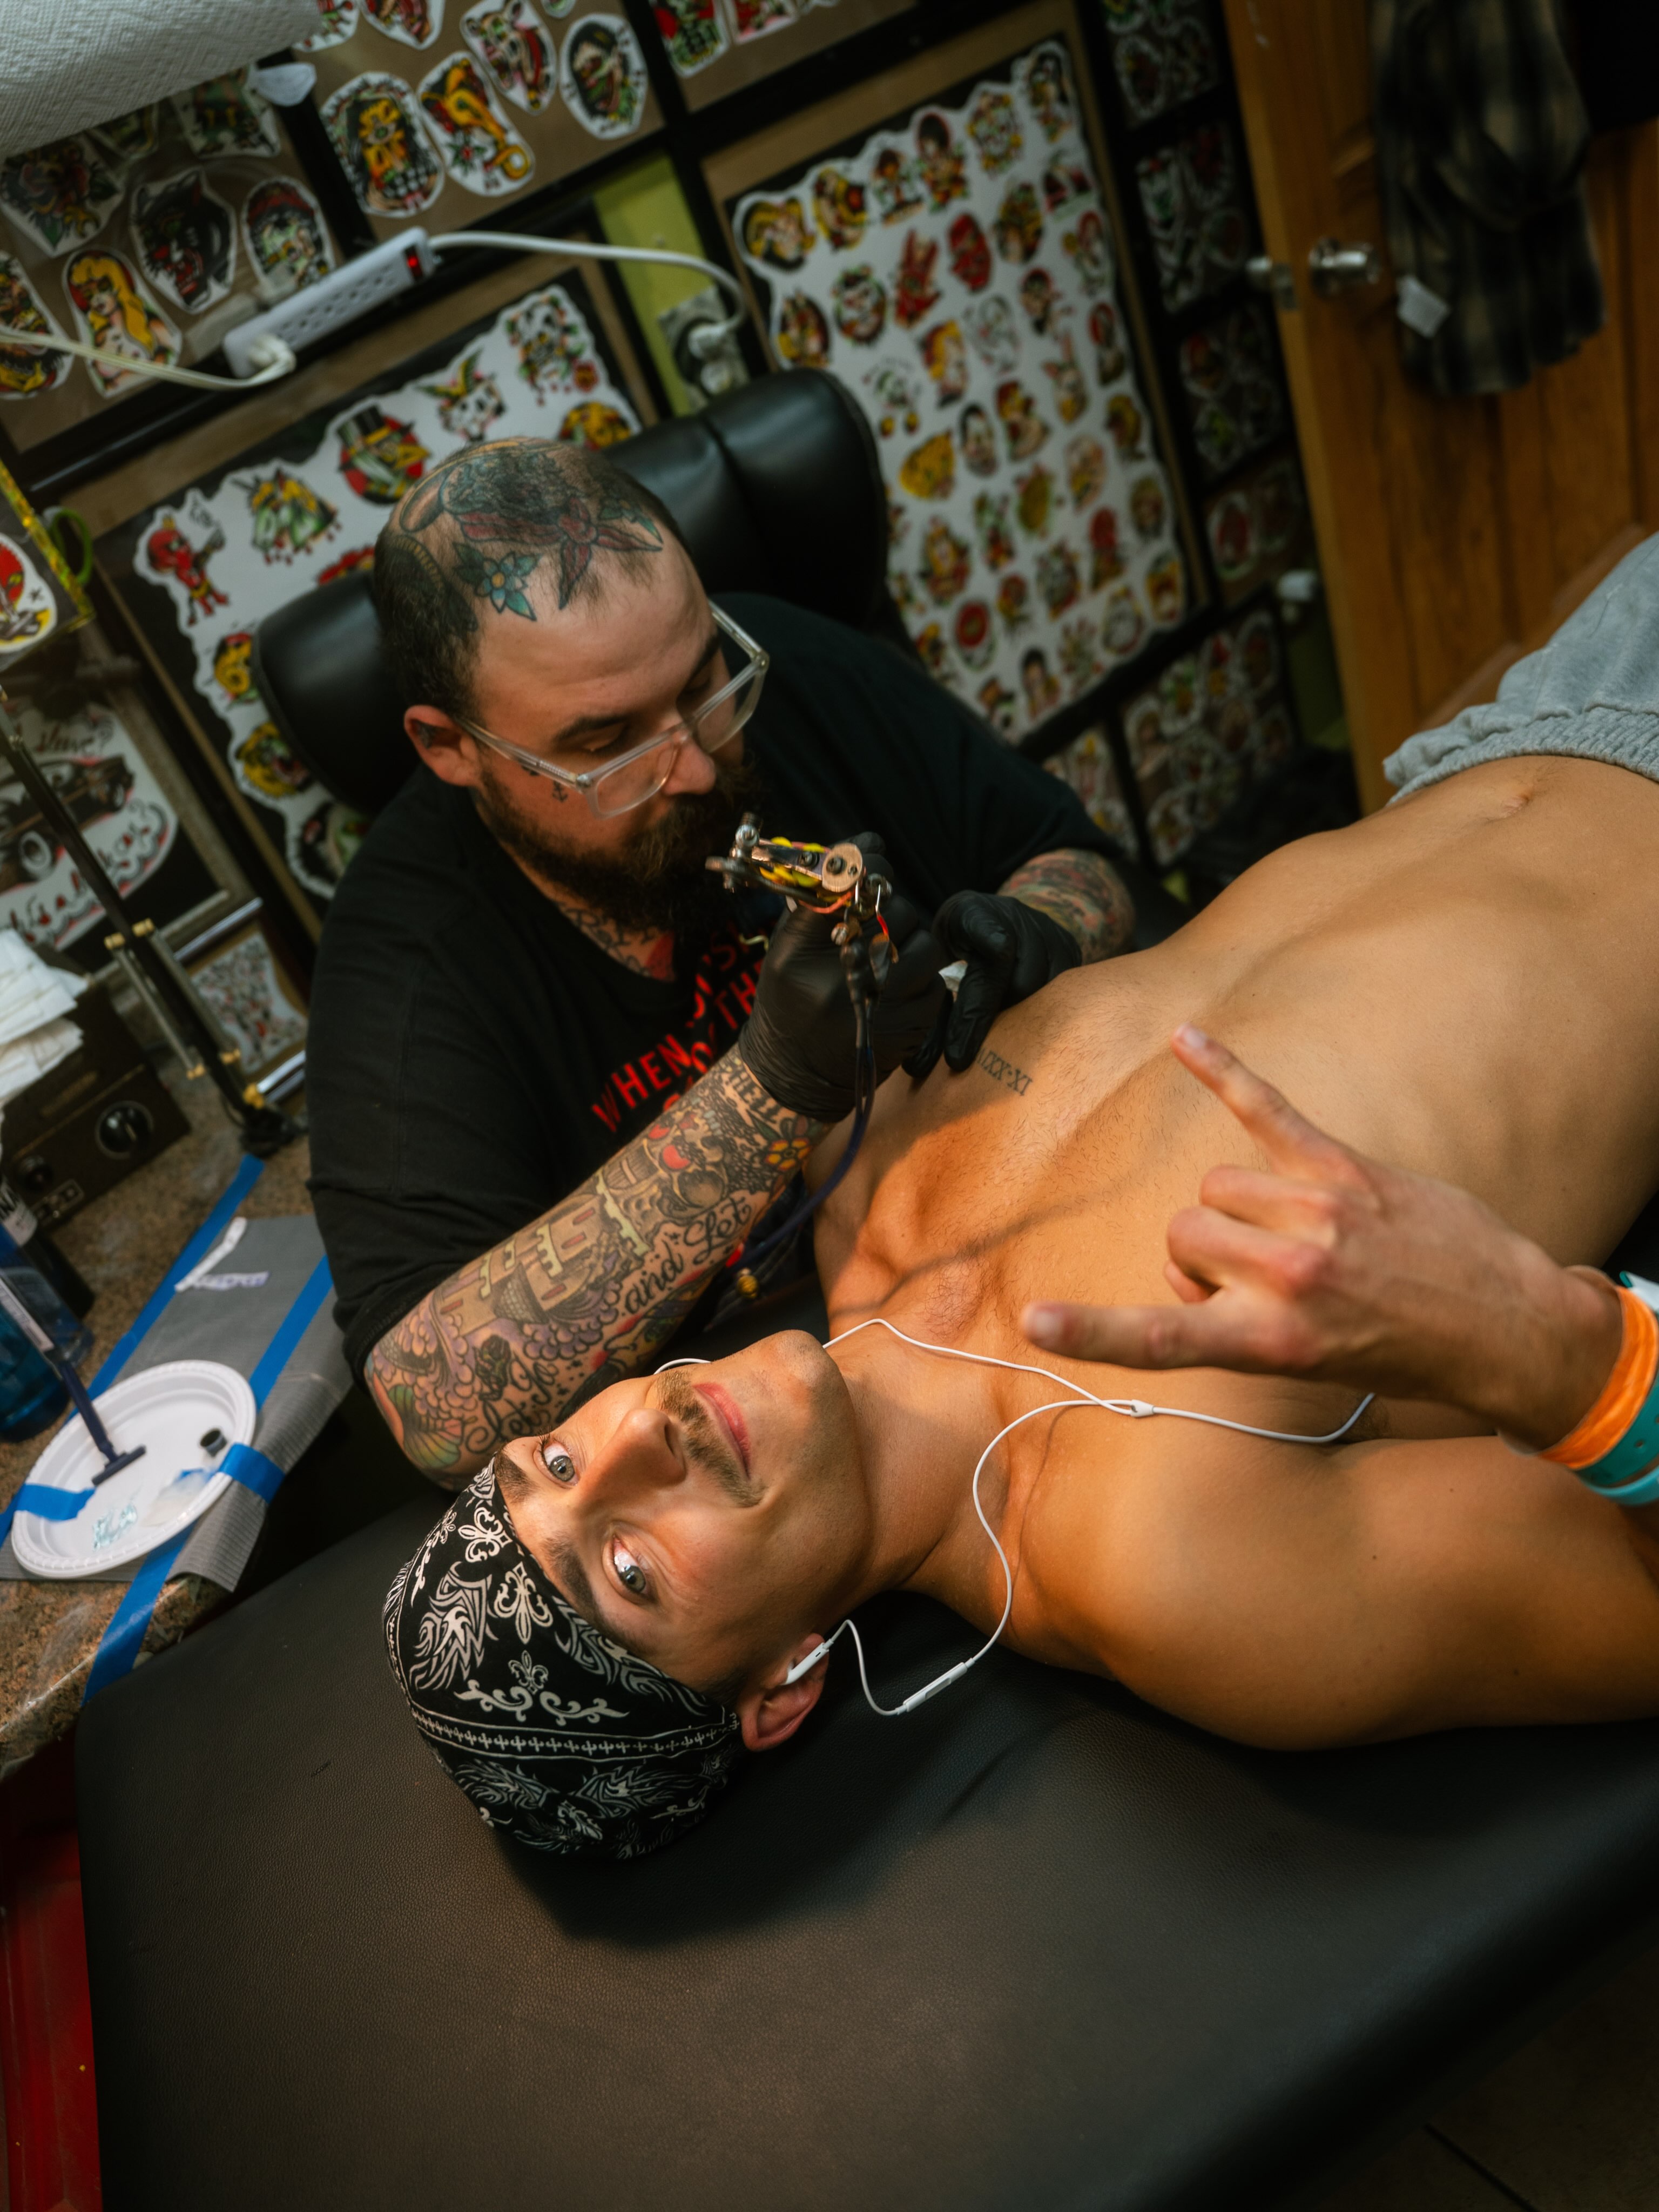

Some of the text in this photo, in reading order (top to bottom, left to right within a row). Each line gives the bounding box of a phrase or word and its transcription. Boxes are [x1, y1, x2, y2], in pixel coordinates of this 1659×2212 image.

[592, 1034, 692, 1132] WHEN
[625, 1238, 684, 1314] and
[683, 1196, 751, 1265] Let
